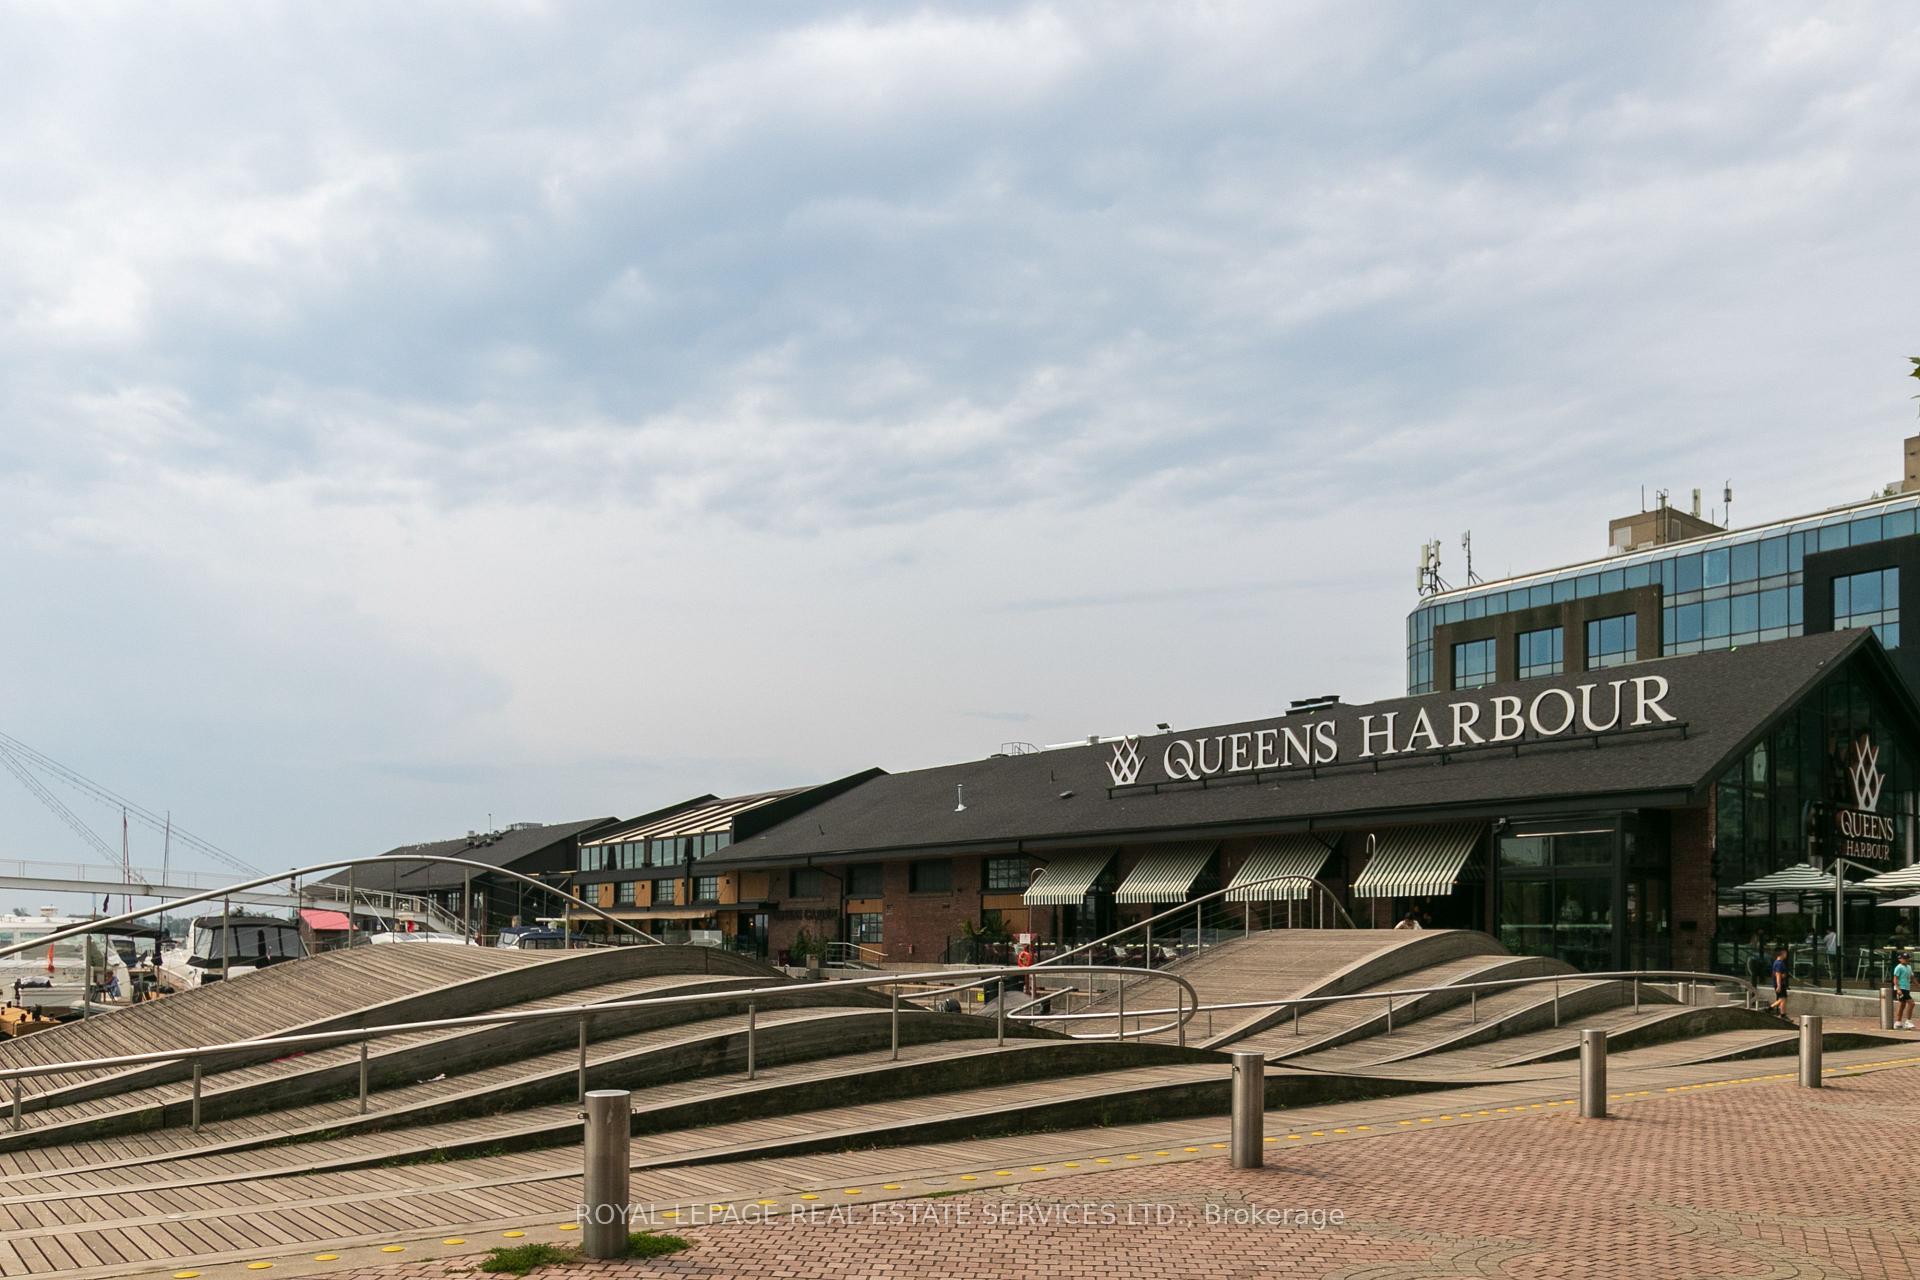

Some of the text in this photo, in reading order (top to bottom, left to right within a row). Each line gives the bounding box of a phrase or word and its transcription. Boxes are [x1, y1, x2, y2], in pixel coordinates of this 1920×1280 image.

[1163, 675, 1678, 781] QUEENS HARBOUR
[1841, 810, 1894, 841] QUEENS
[1847, 840, 1890, 861] HARBOUR
